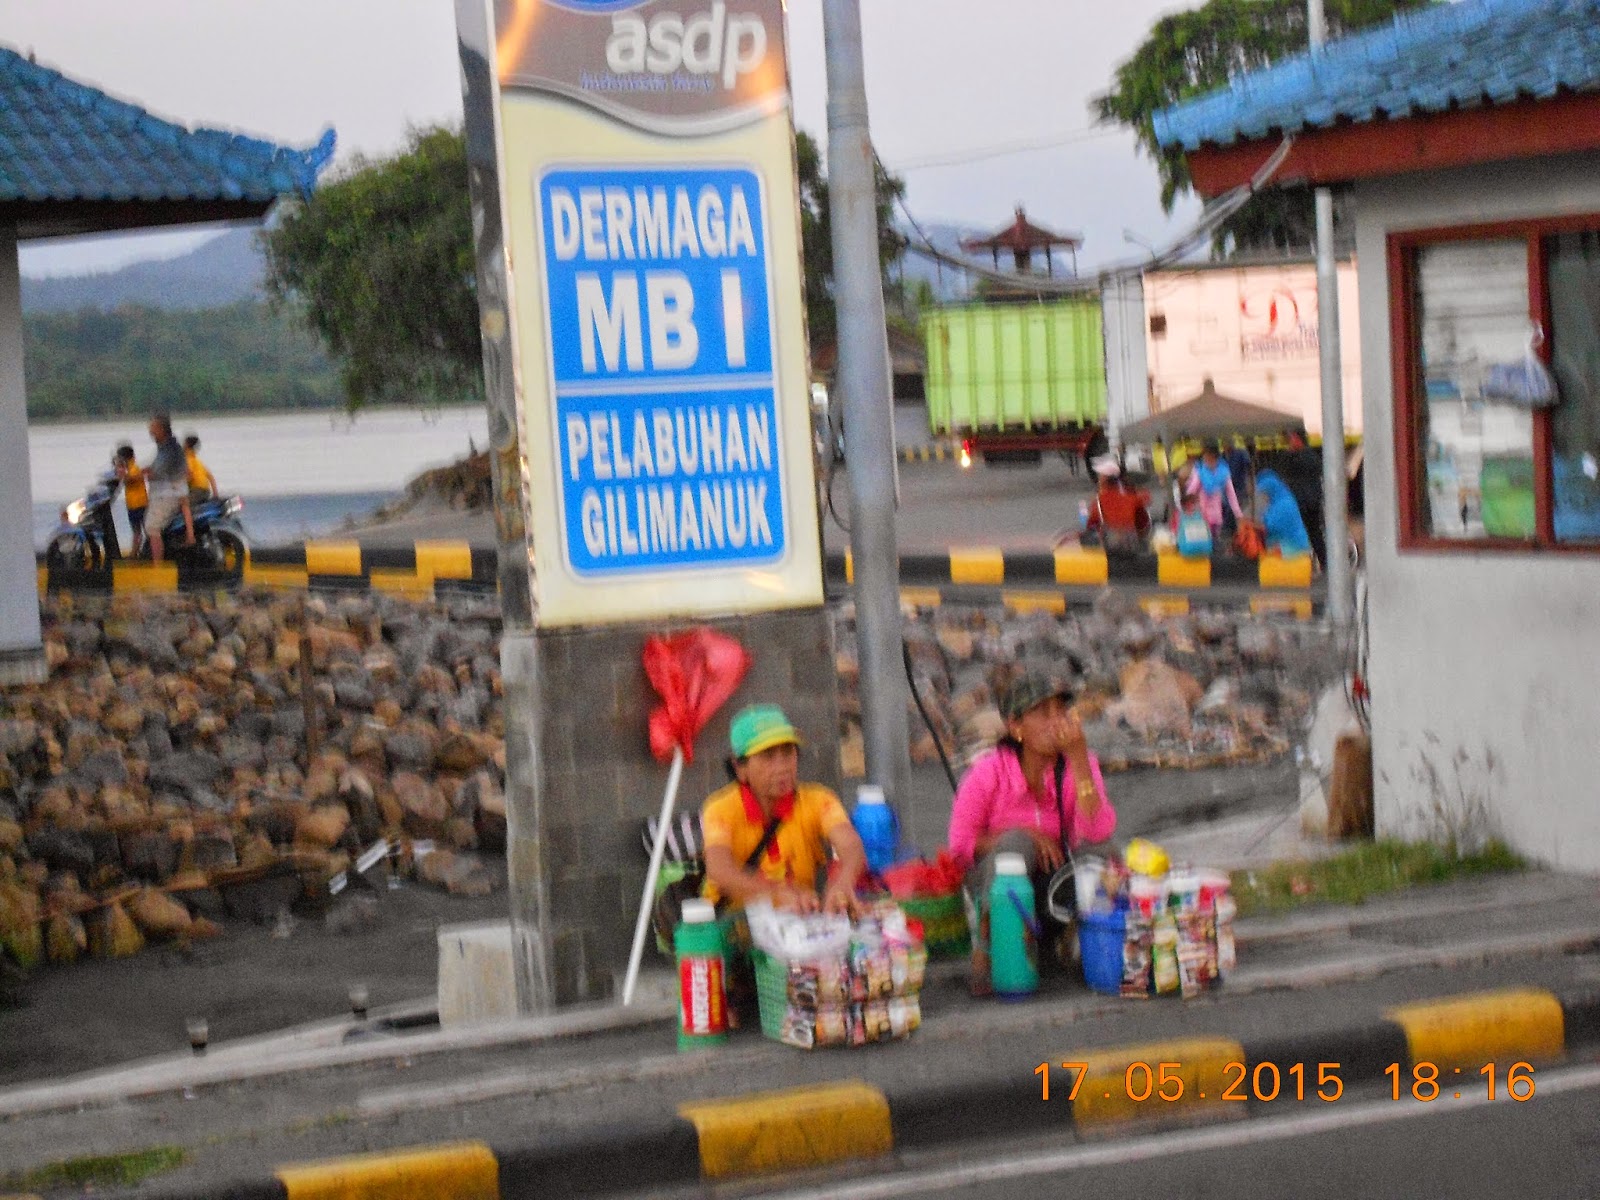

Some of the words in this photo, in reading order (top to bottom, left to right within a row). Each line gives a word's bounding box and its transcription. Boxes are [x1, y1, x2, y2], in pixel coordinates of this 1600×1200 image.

[606, 1, 768, 90] asdp
[550, 186, 757, 261] DERMAGA
[574, 269, 700, 373] MB
[721, 267, 747, 368] I
[566, 404, 772, 481] PELABUHAN
[581, 479, 774, 557] GILIMANUK
